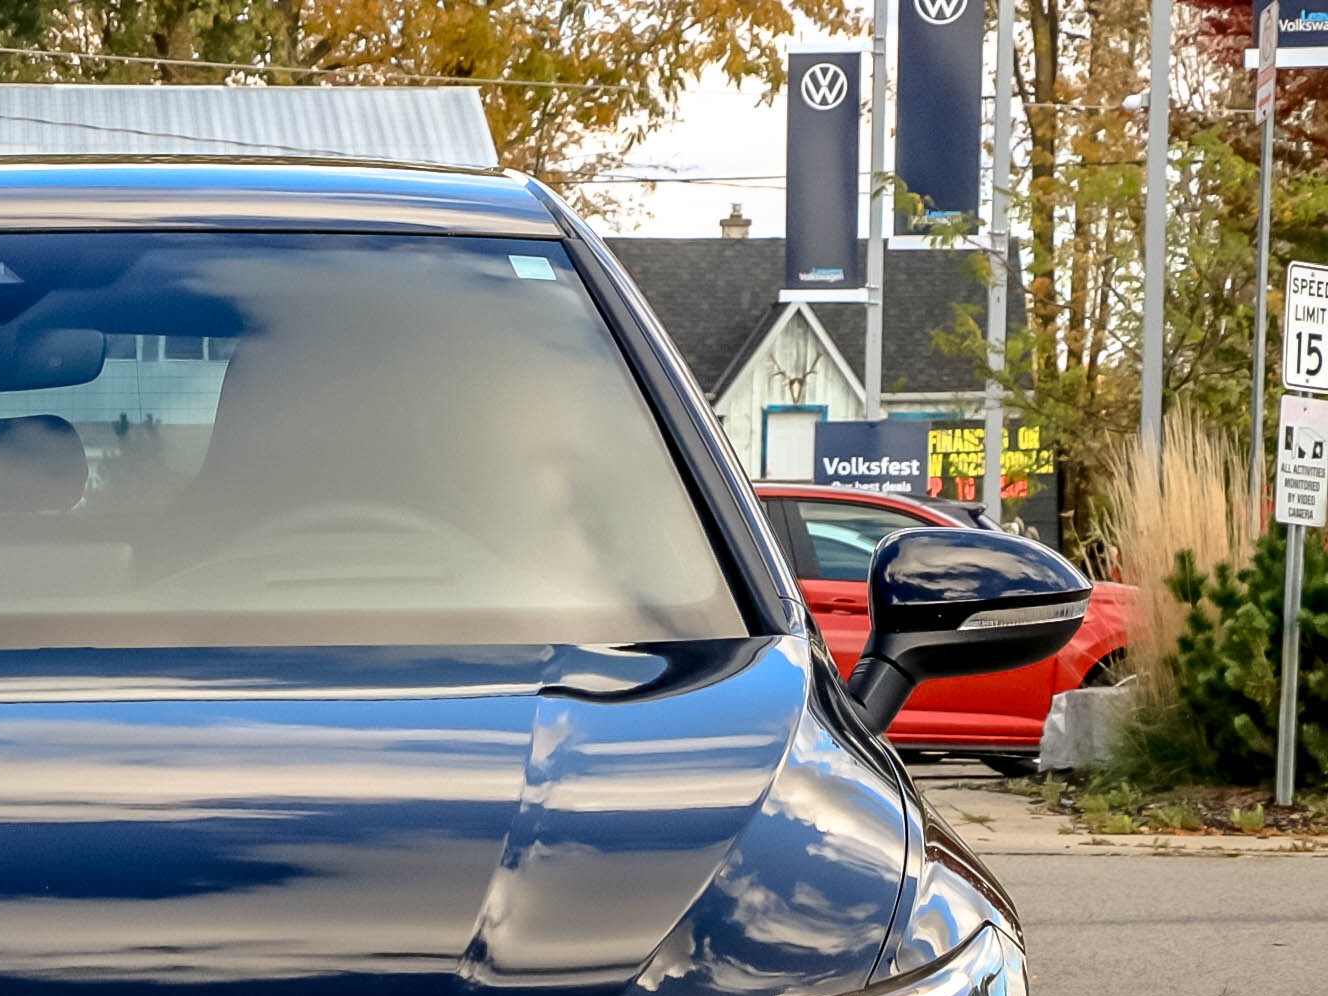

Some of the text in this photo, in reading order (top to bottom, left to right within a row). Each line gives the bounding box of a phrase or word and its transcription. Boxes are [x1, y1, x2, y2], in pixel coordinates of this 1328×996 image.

[1295, 304, 1327, 325] LIMIT
[1296, 331, 1323, 376] 15
[823, 457, 921, 476] Volksfest
[881, 480, 912, 492] deals
